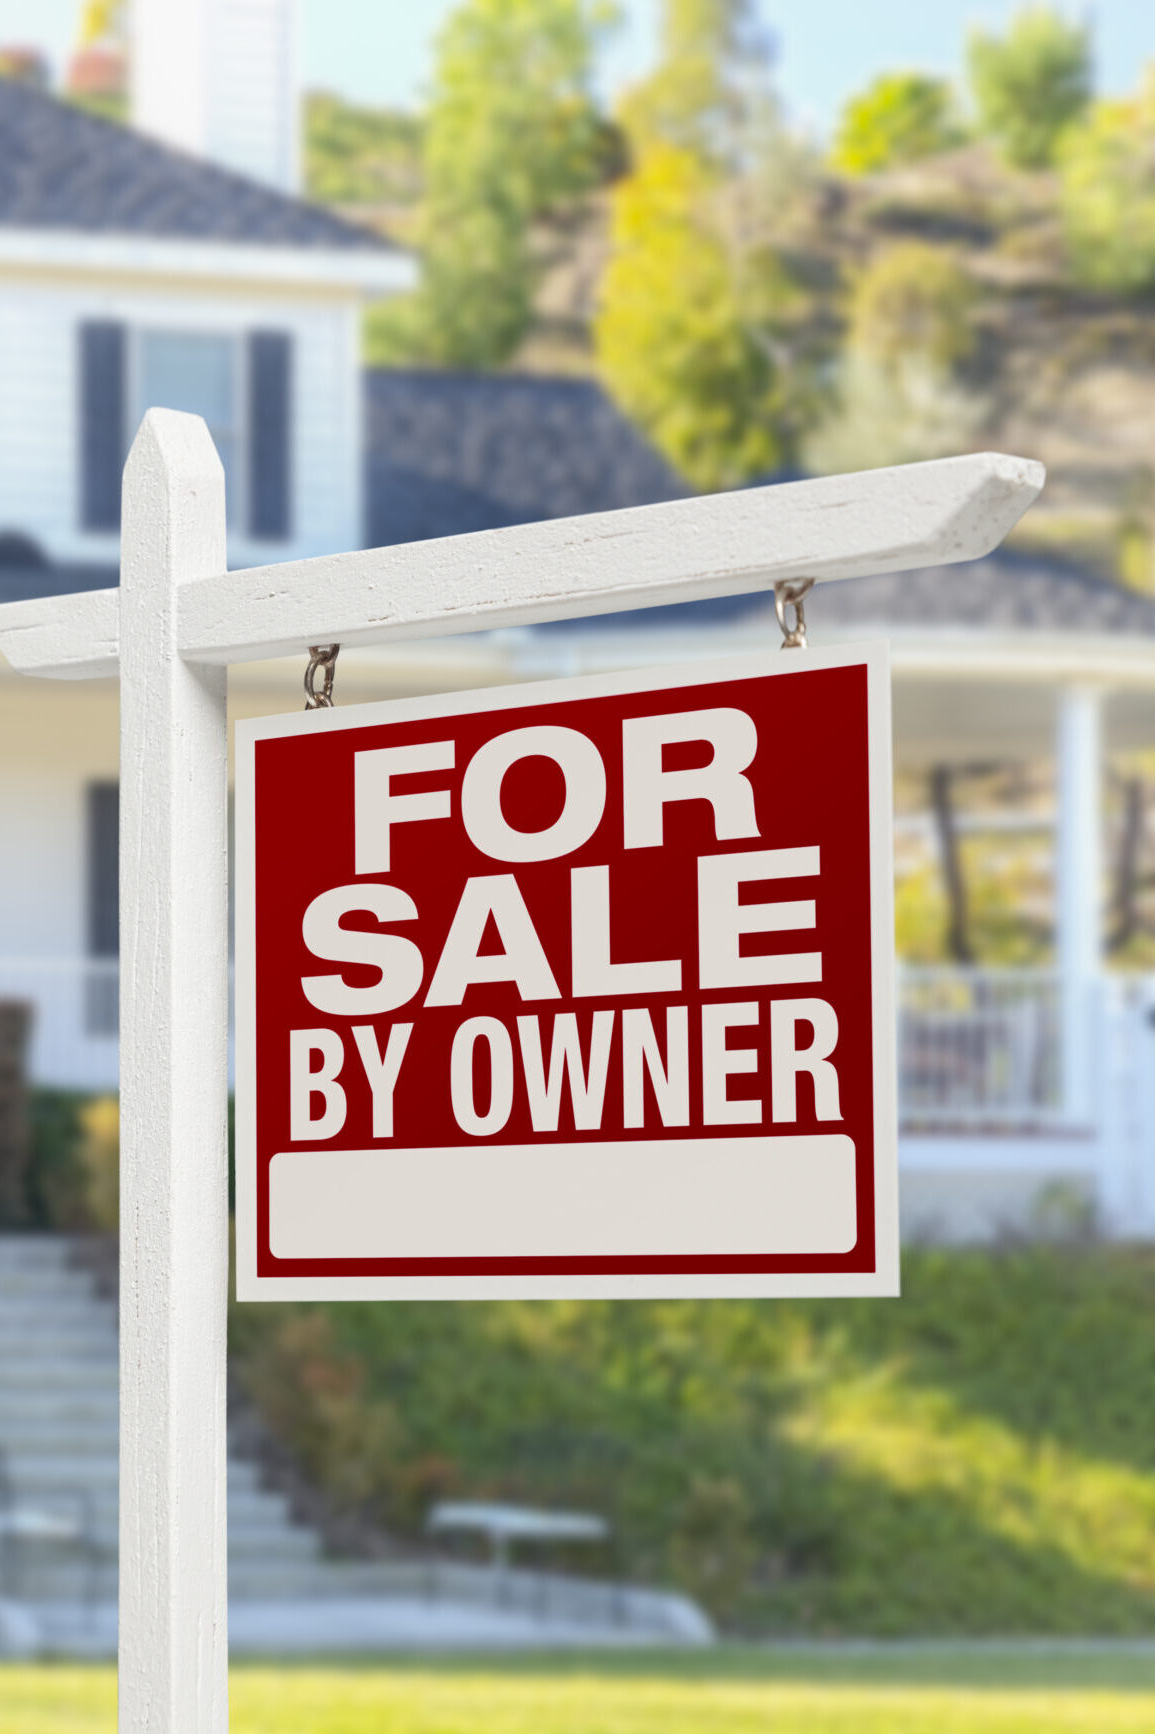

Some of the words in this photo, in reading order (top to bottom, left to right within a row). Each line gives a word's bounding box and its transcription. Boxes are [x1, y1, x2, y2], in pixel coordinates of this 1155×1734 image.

[354, 707, 762, 876] FOR
[300, 845, 823, 1016] SALE
[289, 1022, 414, 1142] BY
[450, 997, 845, 1137] OWNER
